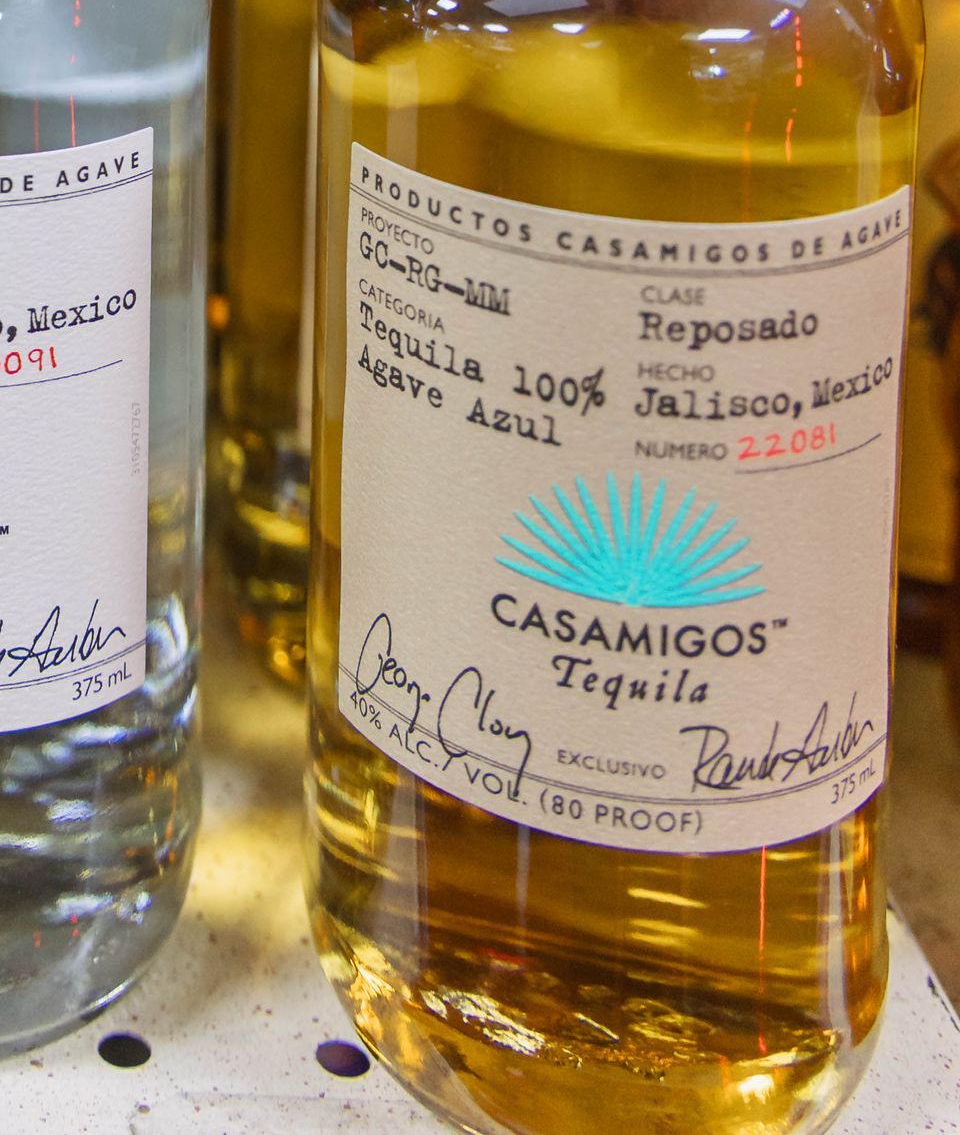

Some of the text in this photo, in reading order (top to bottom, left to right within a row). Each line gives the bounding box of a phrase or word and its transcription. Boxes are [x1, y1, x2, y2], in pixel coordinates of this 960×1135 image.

[0, 174, 34, 194] DE
[55, 151, 140, 188] AGAVE
[360, 165, 902, 264] PRODUCTOS CASAMIGOS DE AGAVE
[360, 206, 435, 256] PROYECTO
[26, 288, 137, 334] Mexico
[358, 277, 446, 334] CATEGORIA
[640, 285, 707, 306] CLASE
[637, 309, 819, 351] Reposado
[358, 299, 606, 417] Tequila 100%
[637, 361, 716, 382] HECHO
[357, 343, 562, 448] Agave Azul
[634, 355, 894, 421] Jalisco, Mexico
[634, 420, 837, 461] NUMERO 22081
[71, 661, 133, 702] 375 mL
[550, 654, 710, 711] Tequila
[349, 690, 382, 731] 40%
[539, 787, 584, 821] (80
[594, 802, 704, 836] PROOF)
[556, 748, 667, 780] EXCLUSIVO
[830, 764, 877, 806] 375 mL
